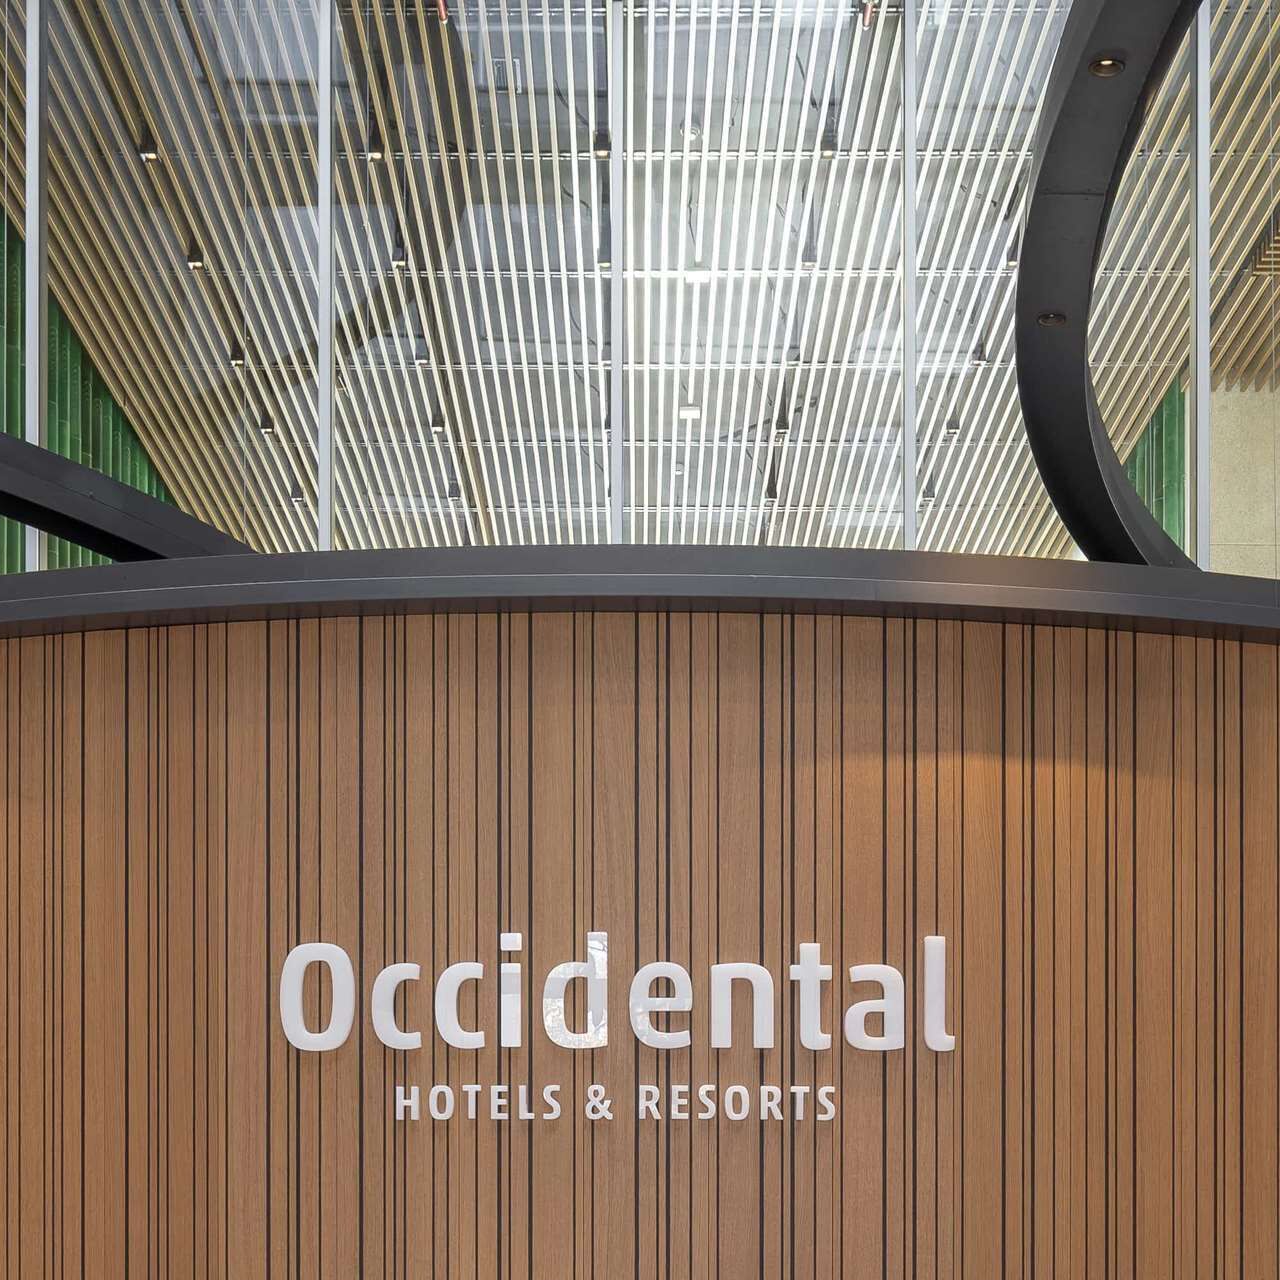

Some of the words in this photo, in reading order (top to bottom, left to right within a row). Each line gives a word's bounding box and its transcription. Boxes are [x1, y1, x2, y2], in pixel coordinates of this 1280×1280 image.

[279, 931, 956, 1052] Occidental
[395, 1084, 562, 1121] HOTELS
[585, 1084, 613, 1121] &
[638, 1084, 837, 1121] RESORTS
